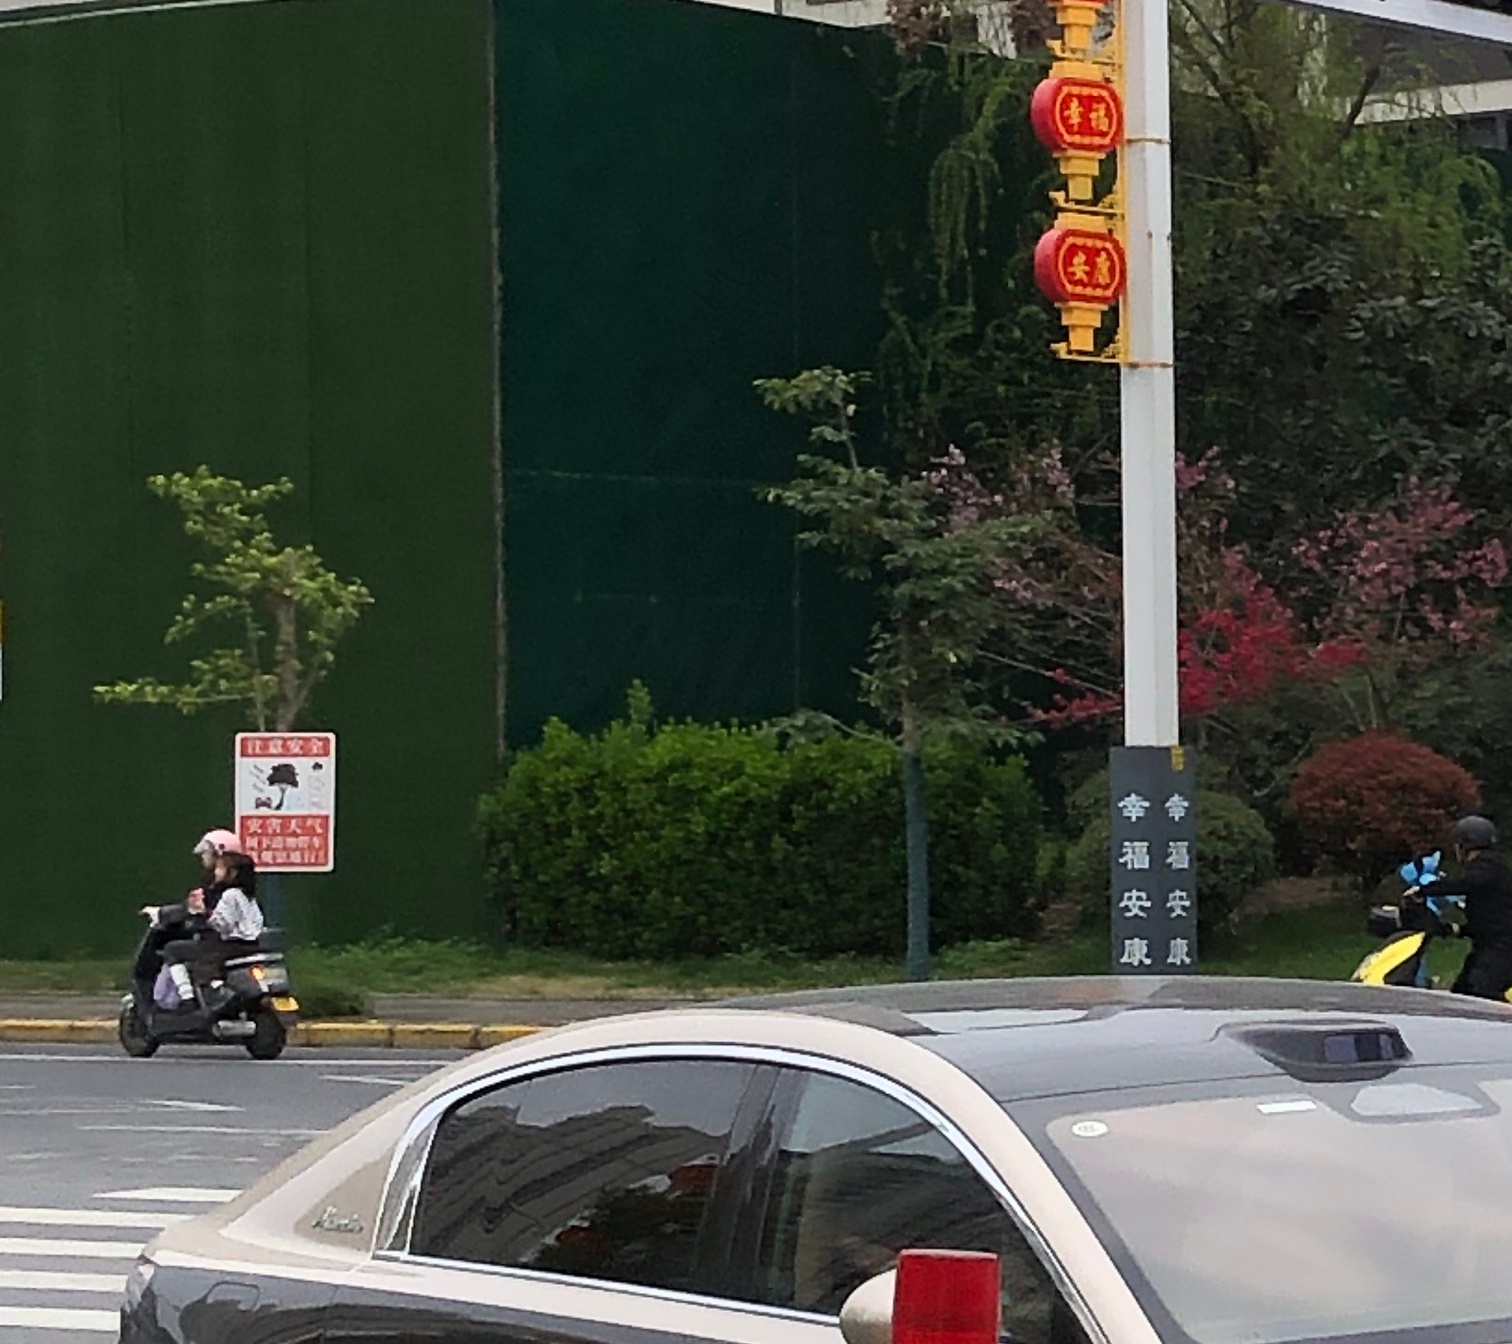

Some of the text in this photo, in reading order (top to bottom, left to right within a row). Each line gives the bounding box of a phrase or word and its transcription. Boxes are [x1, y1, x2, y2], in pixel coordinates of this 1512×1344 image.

[1063, 97, 1110, 134] 幸福
[1067, 250, 1111, 285] 安康
[1117, 793, 1152, 966] 幸福安康
[1164, 793, 1192, 966] 幸福安康
